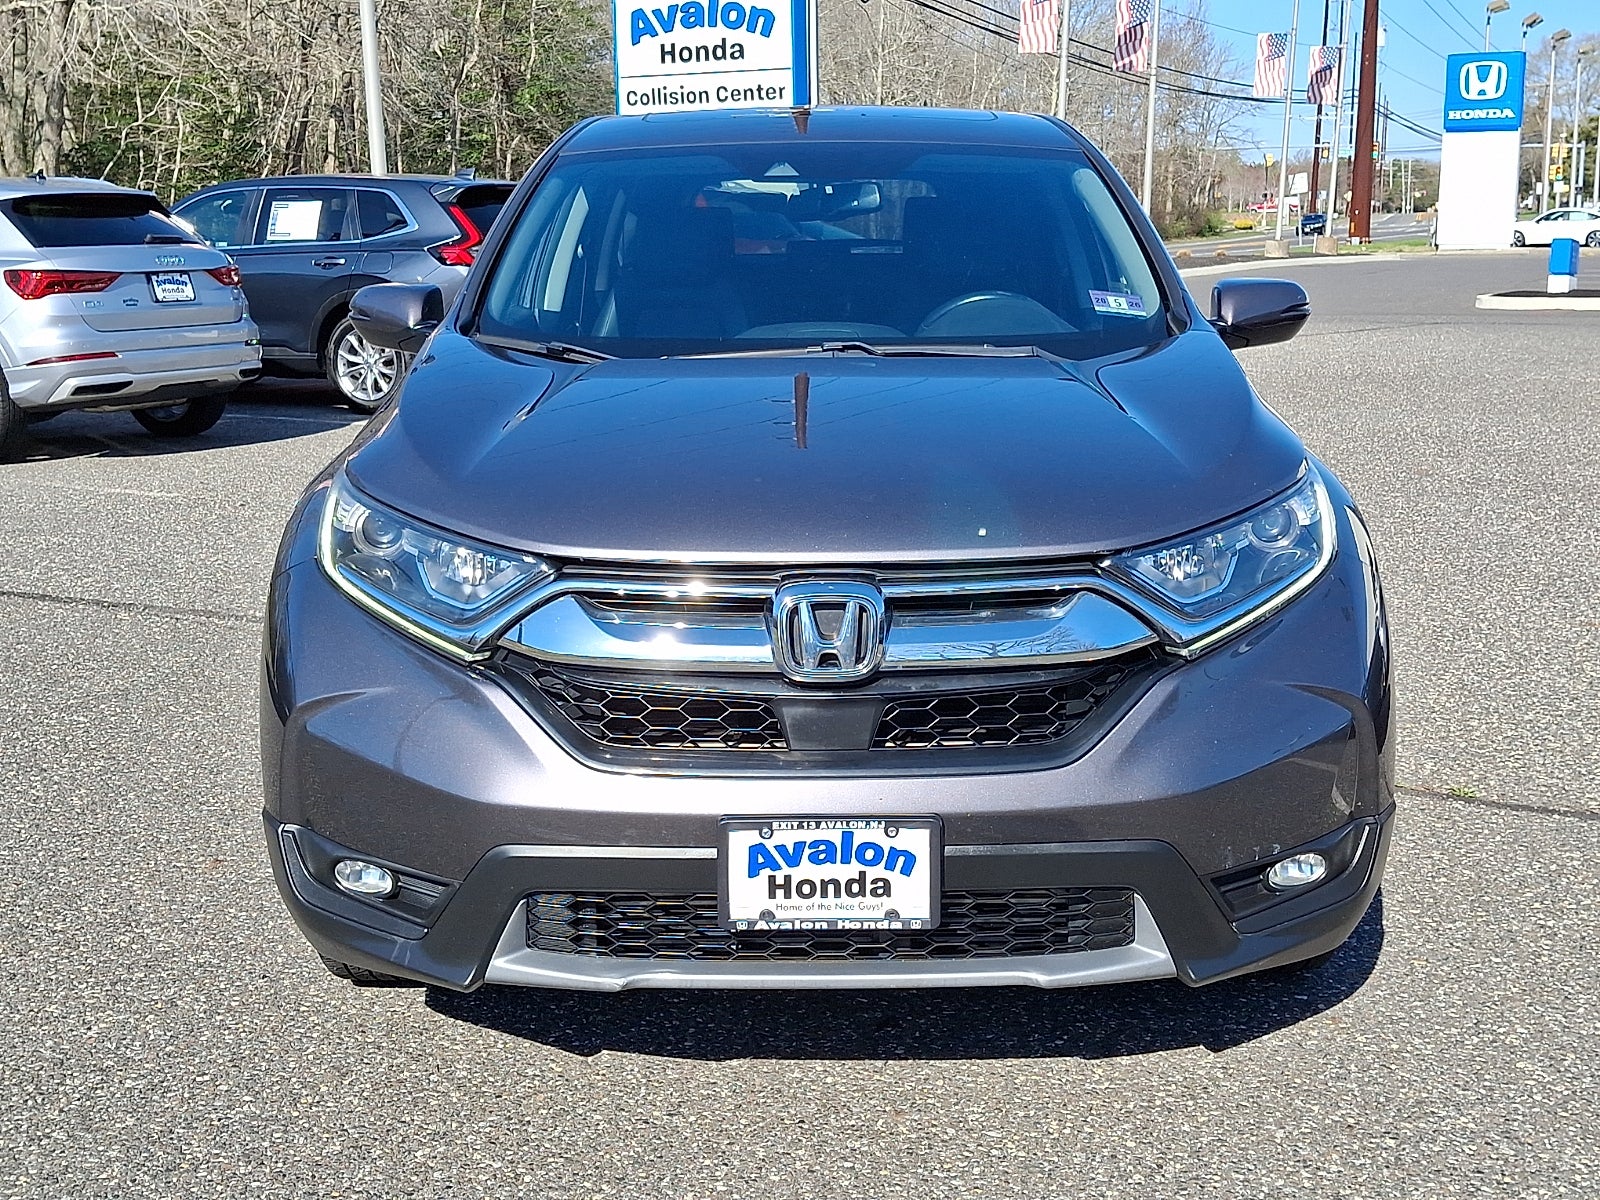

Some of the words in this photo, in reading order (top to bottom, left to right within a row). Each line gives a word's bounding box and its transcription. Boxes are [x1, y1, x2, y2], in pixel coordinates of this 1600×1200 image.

[631, 0, 775, 46] Avalon
[660, 38, 745, 64] Honda
[627, 86, 709, 106] Collision
[716, 84, 786, 103] Center
[1447, 108, 1516, 120] HONDA
[155, 276, 188, 288] Avalon
[161, 286, 185, 294] Honda
[1114, 299, 1122, 307] 5
[772, 821, 800, 830] EXIT
[803, 821, 816, 830] 13
[748, 831, 917, 878] Avalon
[768, 871, 892, 899] Honda
[776, 903, 803, 911] Home
[806, 903, 815, 911] of
[818, 903, 832, 911] the
[835, 903, 855, 911] Nice
[858, 902, 884, 913] Guys!
[753, 919, 829, 930] Avalon
[837, 919, 903, 930] Honda
